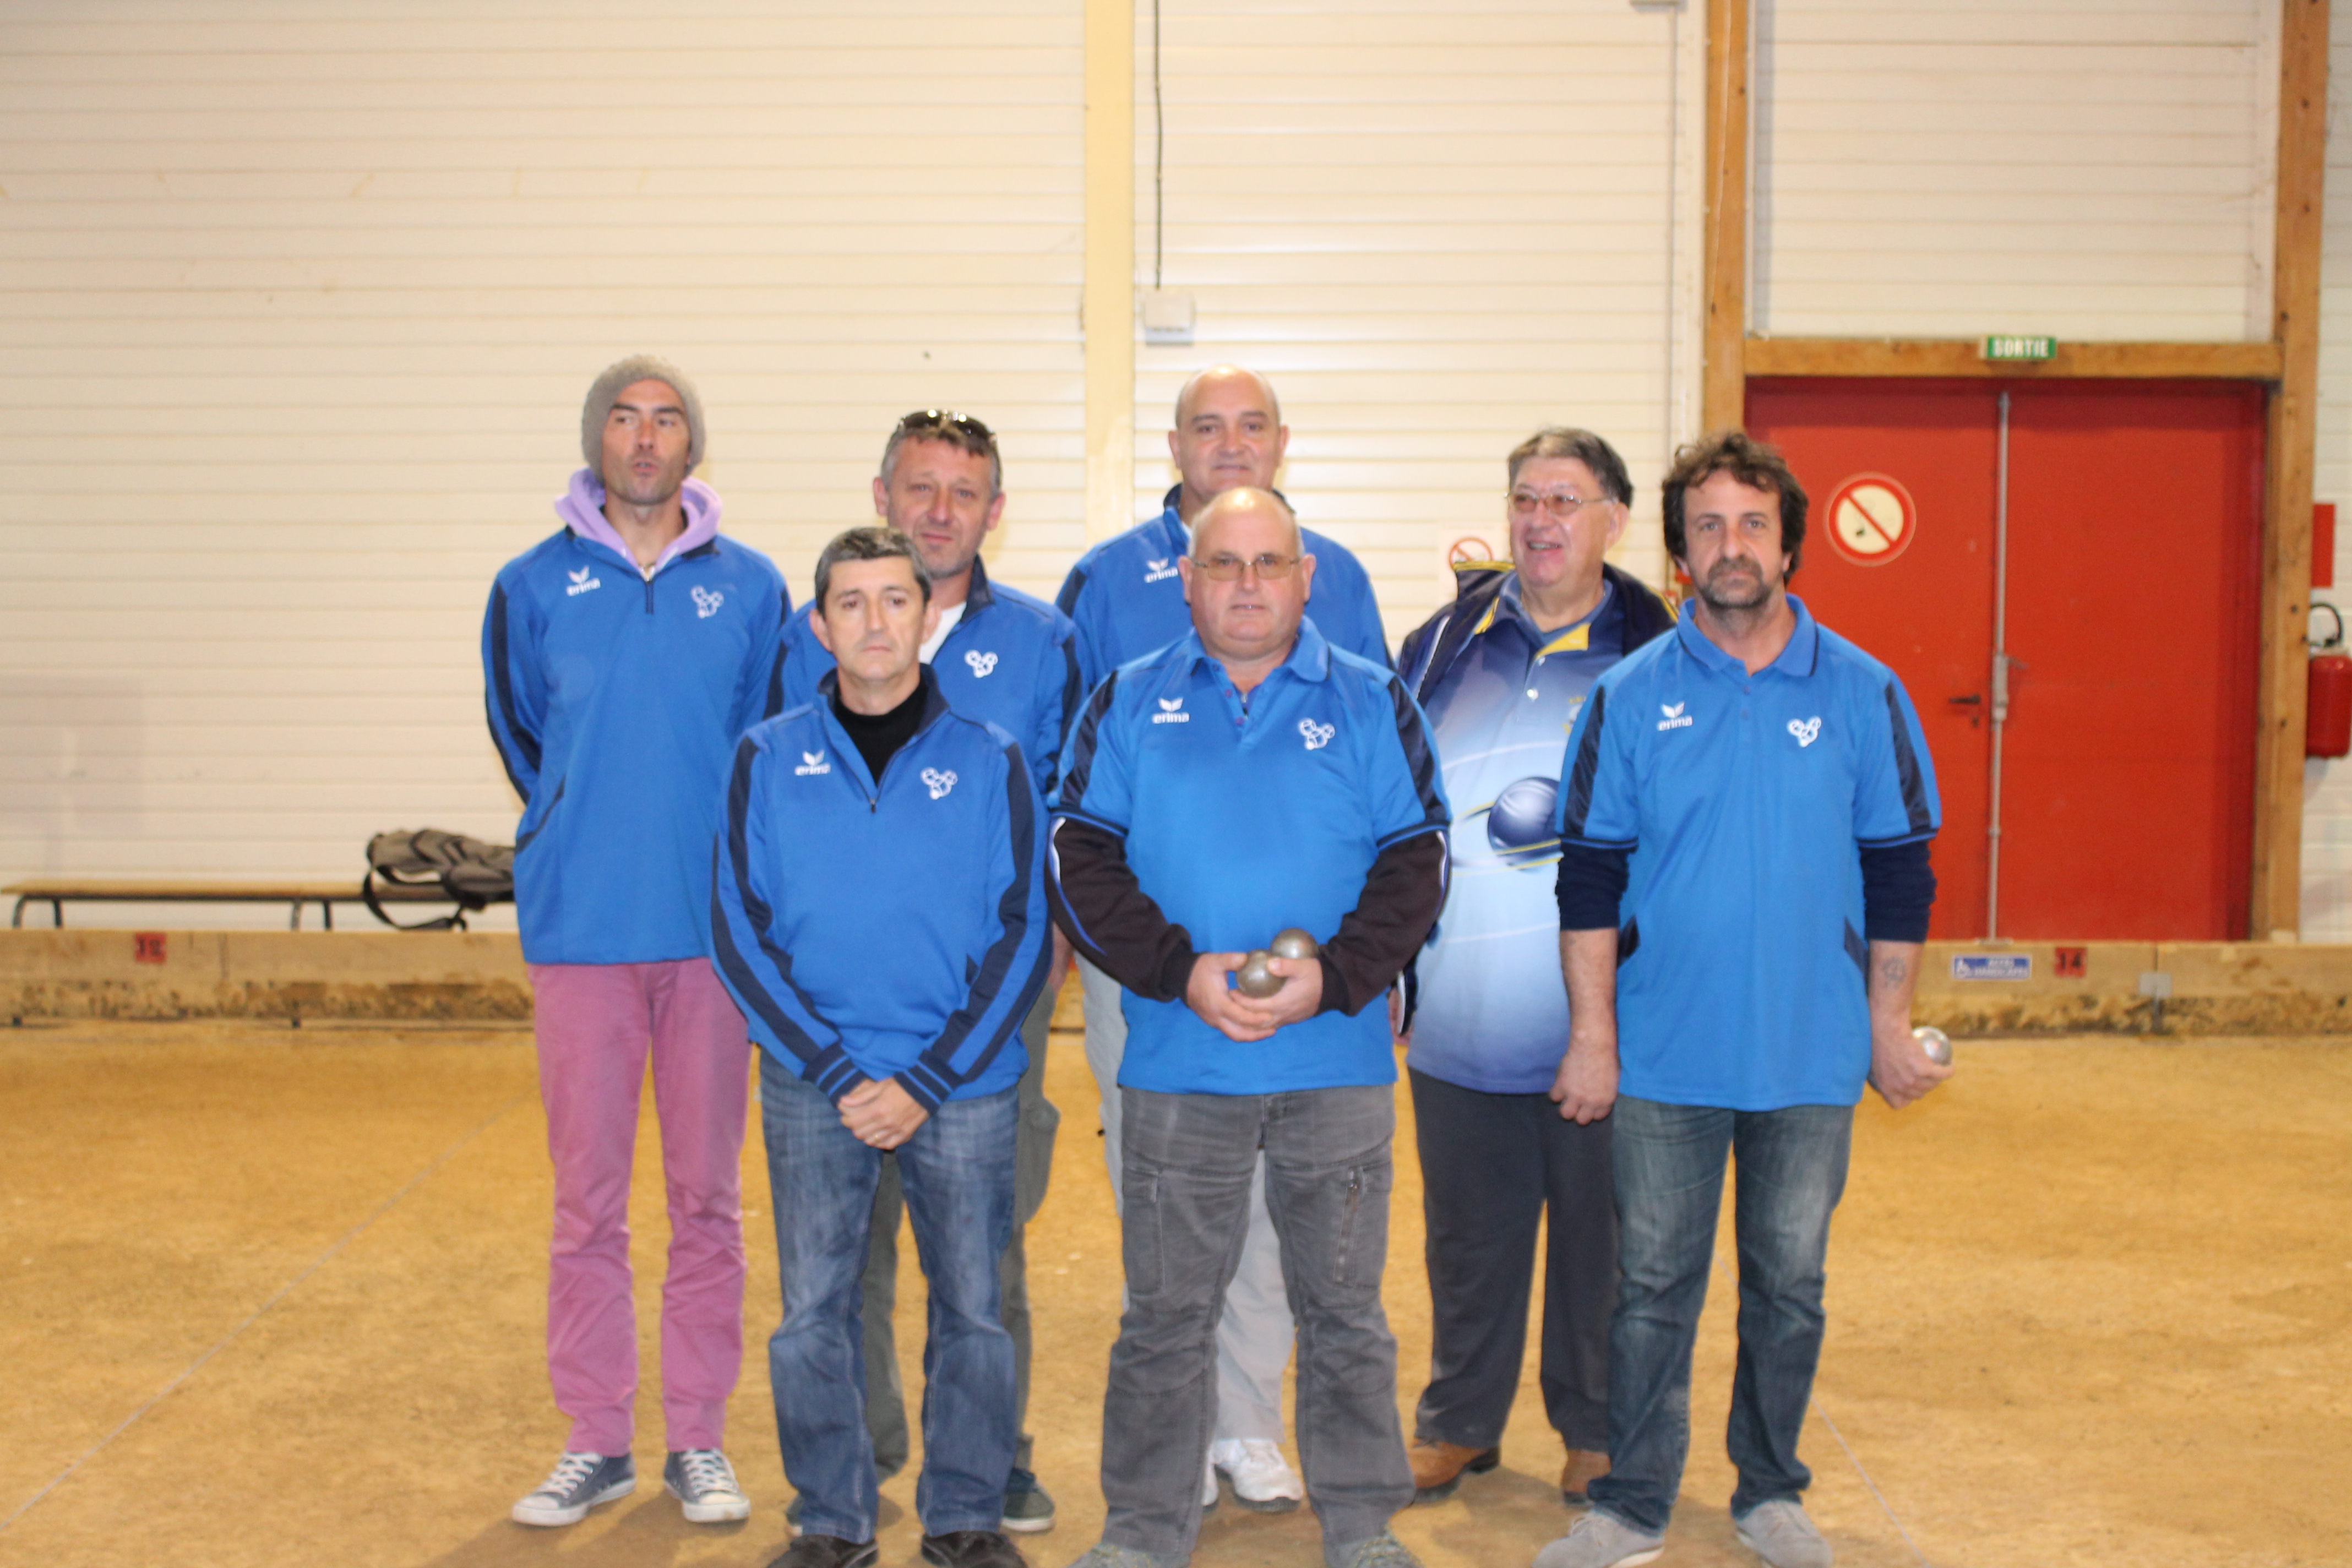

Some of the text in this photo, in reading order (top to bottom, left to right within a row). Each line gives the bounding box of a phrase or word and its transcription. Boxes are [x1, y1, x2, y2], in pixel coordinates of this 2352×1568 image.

[1992, 337, 2048, 357] SORTIE
[1144, 566, 1178, 583] erima
[1151, 712, 1190, 725] erima
[1656, 715, 1693, 732] erima
[794, 763, 831, 776] erima
[2060, 952, 2082, 970] 14
